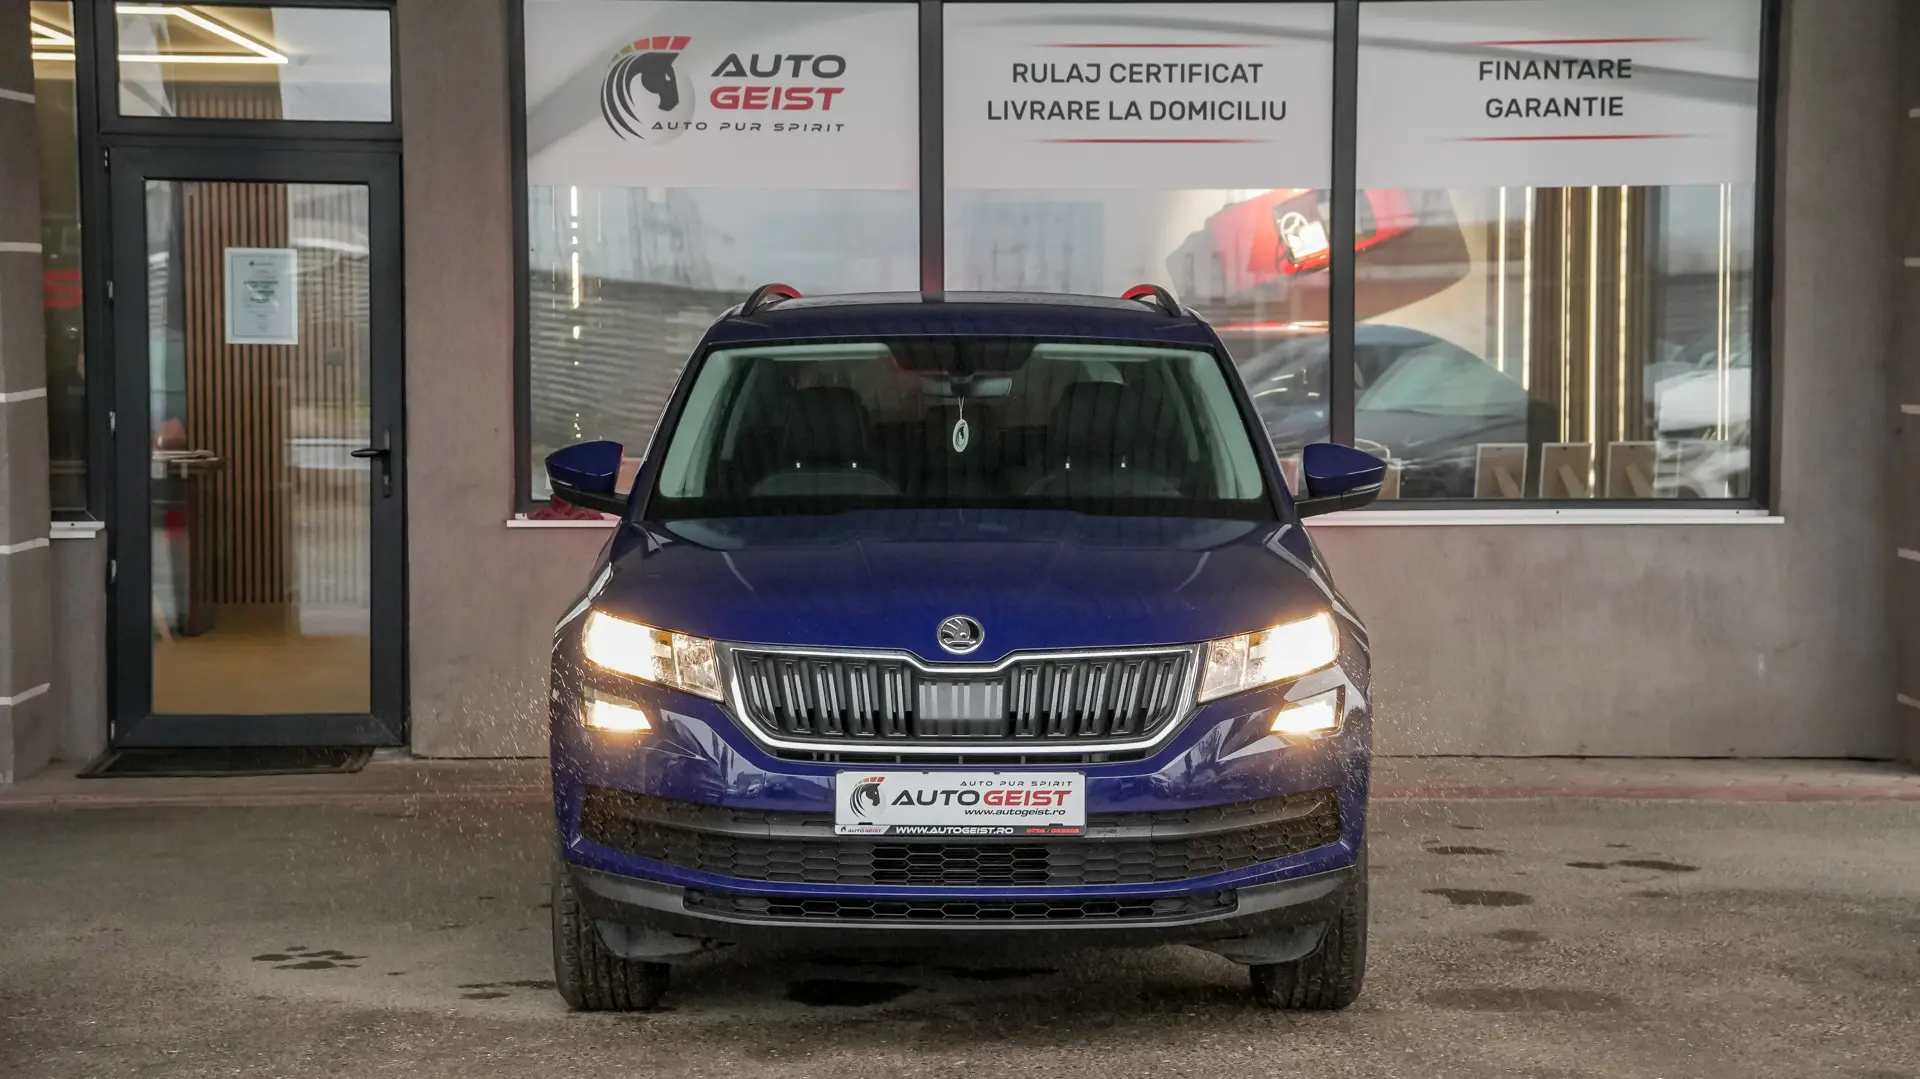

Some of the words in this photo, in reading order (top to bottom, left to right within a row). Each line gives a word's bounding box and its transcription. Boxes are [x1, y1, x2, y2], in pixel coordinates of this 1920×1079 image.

[710, 53, 846, 78] AUTO
[1012, 63, 1102, 83] RULAJ
[1109, 63, 1263, 83] CERTIFICAT
[1479, 58, 1632, 81] FINANTARE
[710, 85, 846, 111] GEIST
[1485, 96, 1624, 118] GARANTIE
[987, 100, 1101, 121] LIVRARE
[1108, 100, 1143, 121] LA
[1150, 100, 1287, 121] DOMICILIU
[651, 121, 708, 131] AUTO
[719, 122, 762, 132] PUR
[773, 122, 845, 132] SPIRIT
[964, 808, 1066, 818] www.autogeist.ro
[895, 826, 1014, 835] WWW.AUTOGEIST.RO
